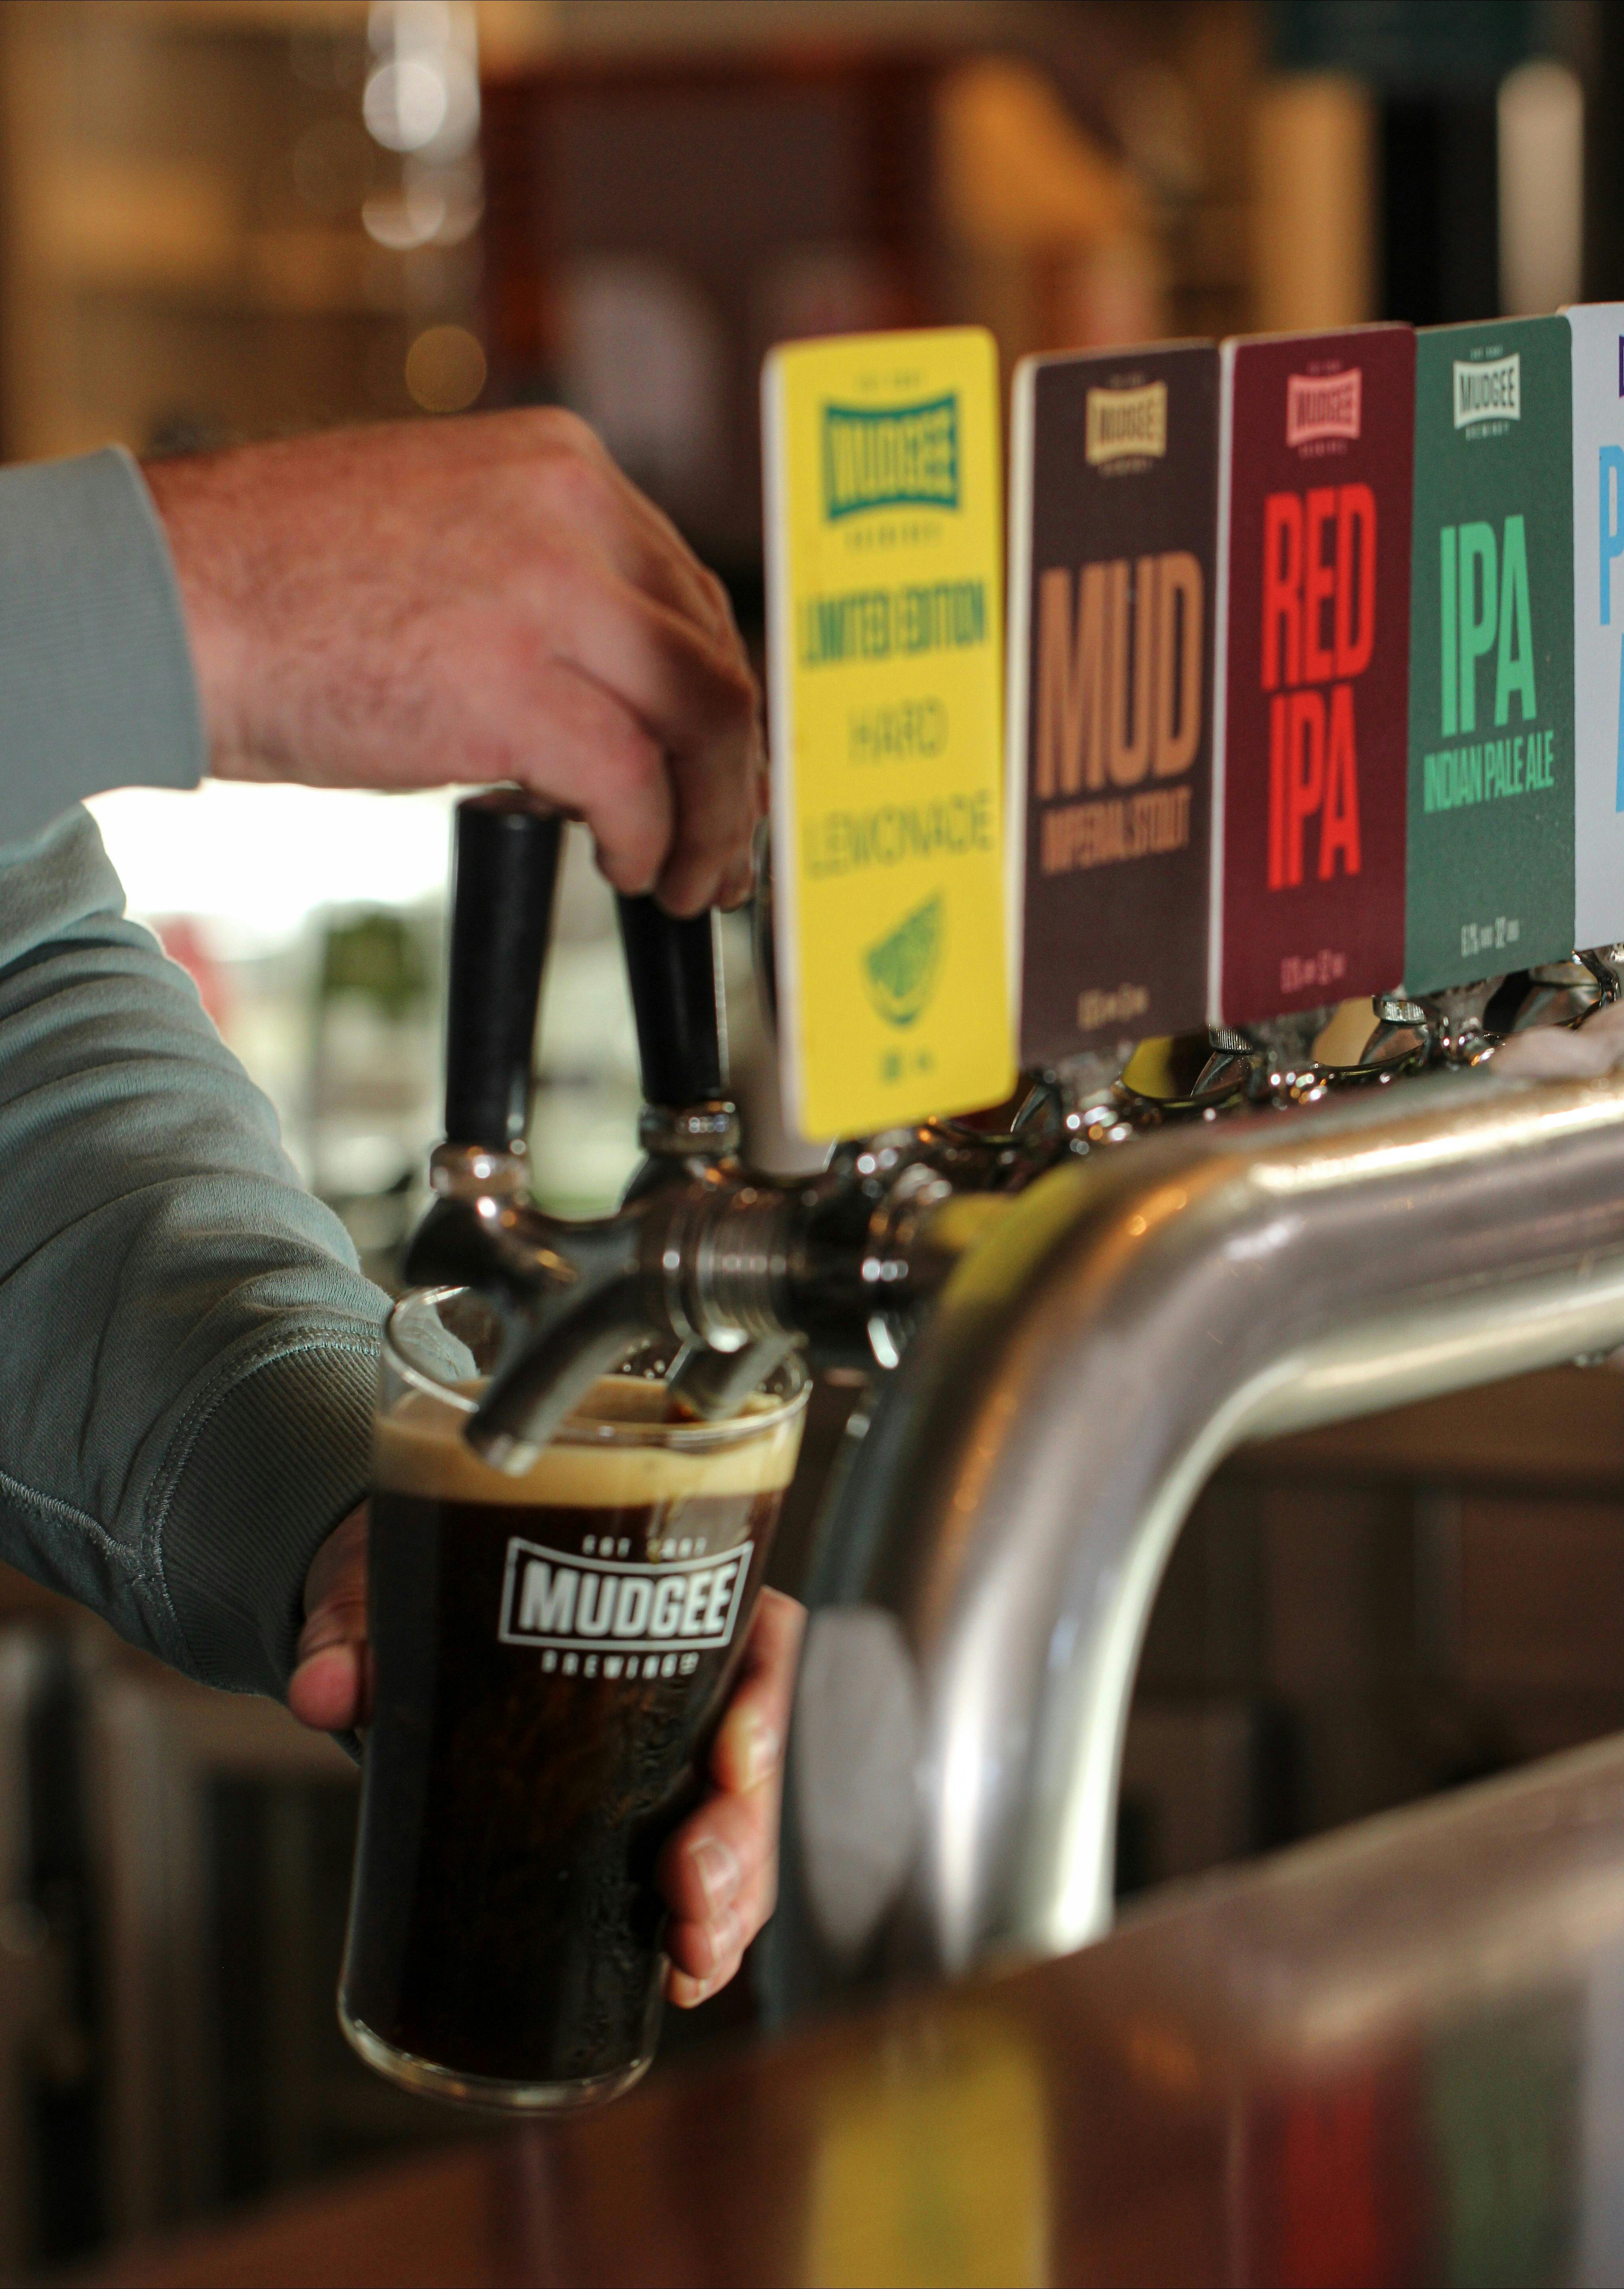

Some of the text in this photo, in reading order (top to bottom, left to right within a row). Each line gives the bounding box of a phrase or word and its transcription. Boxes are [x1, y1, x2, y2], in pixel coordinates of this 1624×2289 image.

[1458, 365, 1516, 415] MUDGEE
[1035, 550, 1204, 801] MUD
[1261, 482, 1377, 692] RED
[1440, 514, 1537, 737] IPA
[1268, 683, 1362, 892] IPA
[1423, 730, 1554, 814] INDIAN PALE ALE
[518, 1560, 738, 1639] MUDGEE
